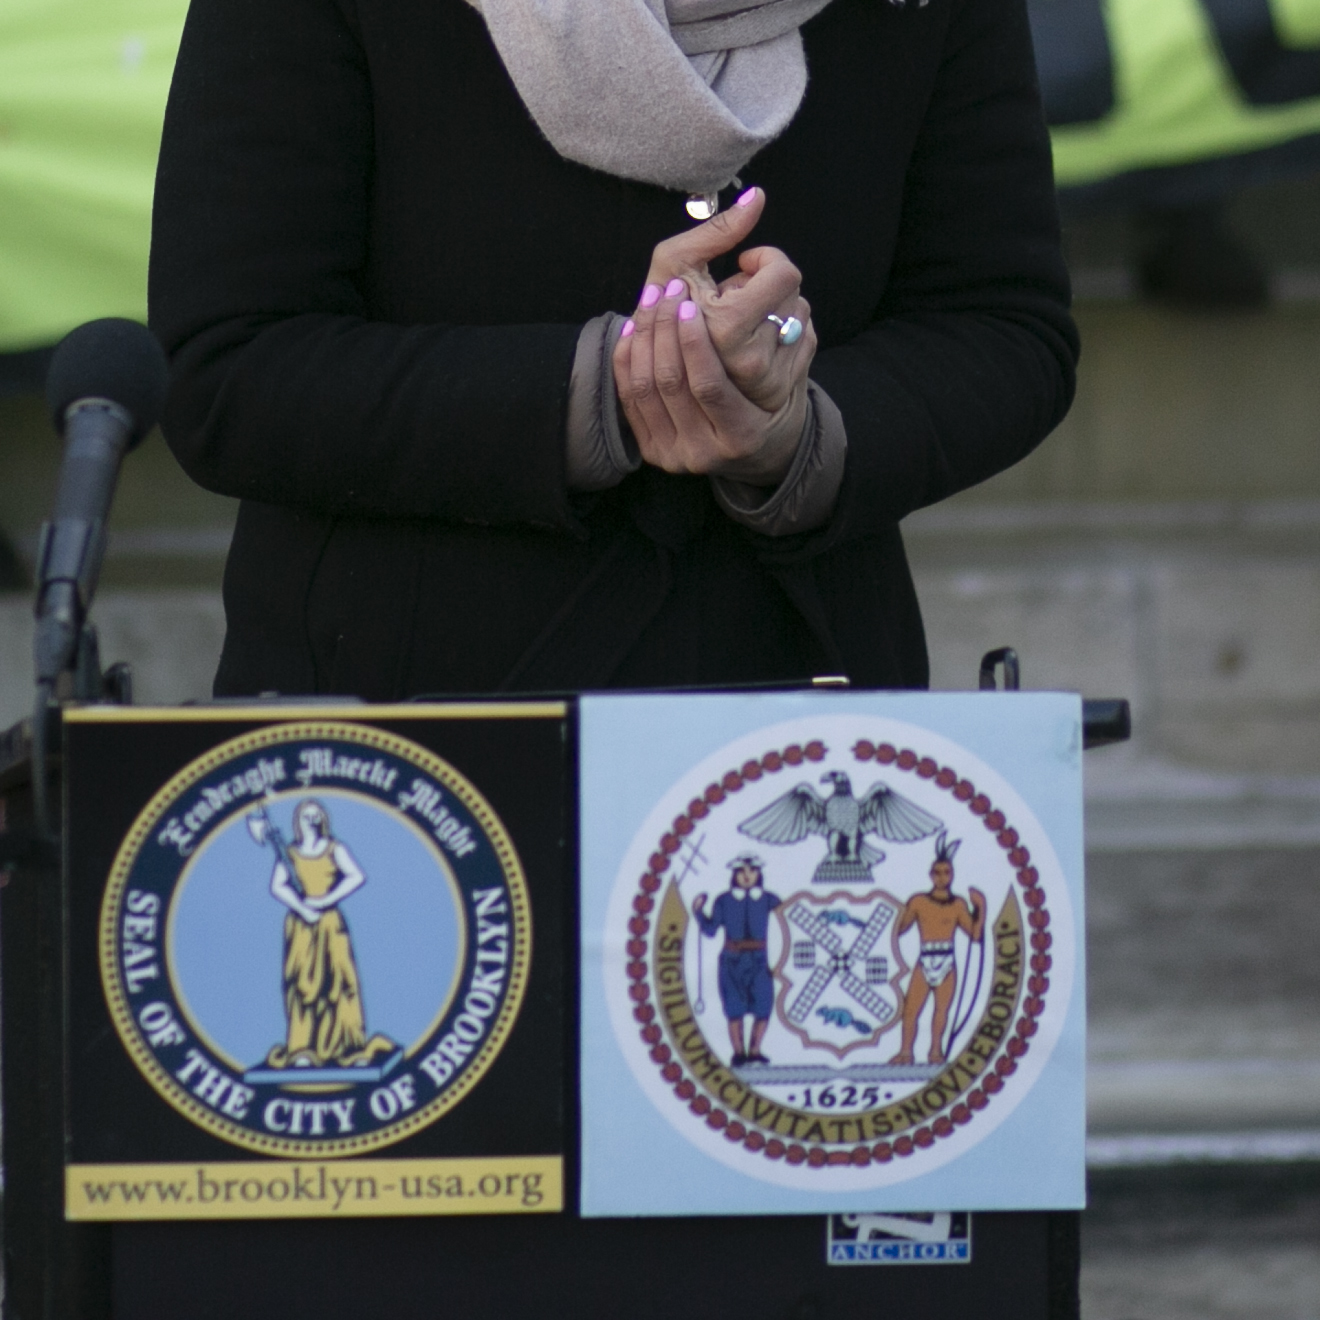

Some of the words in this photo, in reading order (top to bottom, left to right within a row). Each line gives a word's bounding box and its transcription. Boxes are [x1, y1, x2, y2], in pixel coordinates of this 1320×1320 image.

[123, 889, 160, 993] SEAL
[419, 886, 509, 1088] BROOKLYN
[140, 1002, 185, 1048] OF
[176, 1049, 256, 1120] THE
[370, 1075, 419, 1121] OF
[802, 1085, 880, 1109] 1625
[264, 1098, 356, 1135] CITY
[83, 1166, 544, 1210] www.brooklyn-usa.org
